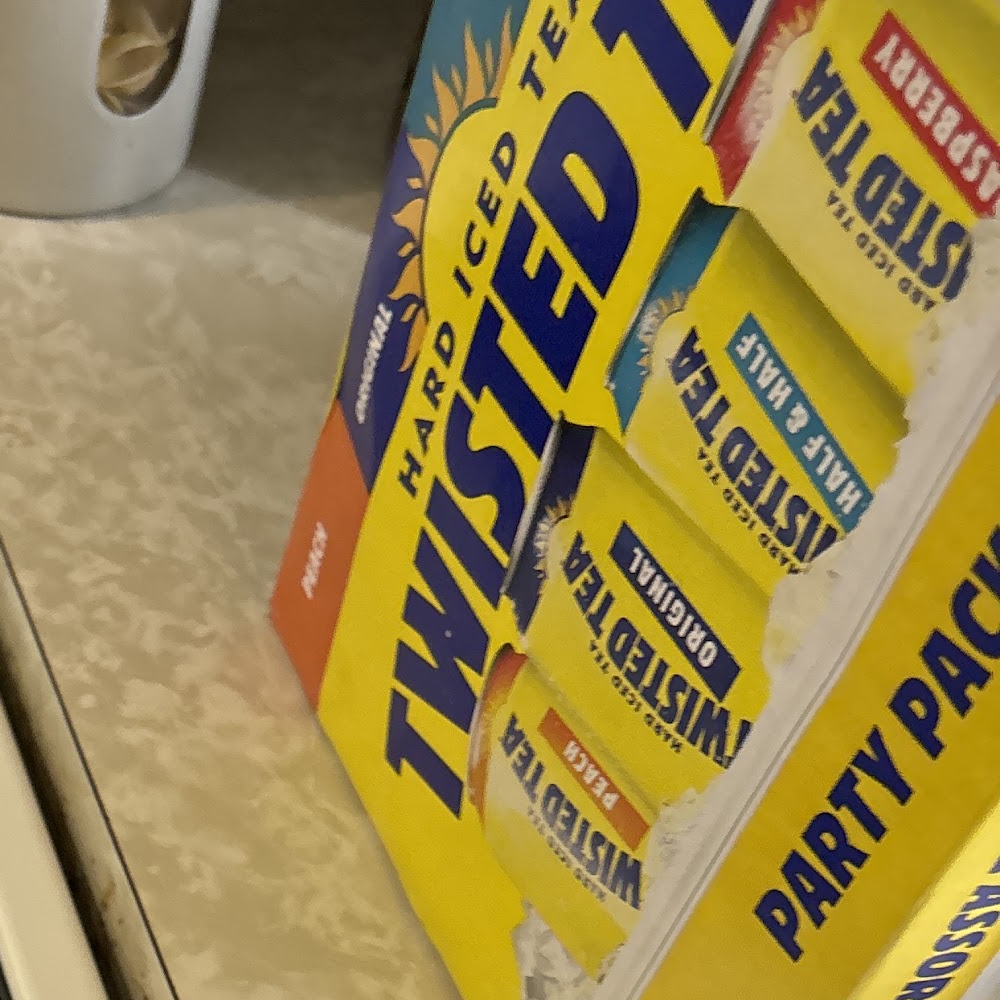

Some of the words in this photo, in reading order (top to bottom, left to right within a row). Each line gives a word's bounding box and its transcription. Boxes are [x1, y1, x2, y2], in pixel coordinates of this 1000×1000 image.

[793, 47, 872, 188] TEA
[399, 321, 456, 498] HARD
[453, 131, 516, 299] ICED
[519, 0, 578, 101] TE
[669, 325, 732, 447] TEA
[735, 332, 793, 412] HALF
[785, 402, 811, 434] &
[385, 91, 639, 819] TWISTED
[722, 488, 757, 531] ICED
[801, 434, 863, 515] HALF
[561, 530, 615, 640] TEA
[628, 546, 718, 668] ORIGINAL
[499, 712, 545, 804] TEA
[562, 739, 621, 811] PEACH
[754, 724, 914, 963] PARTY
